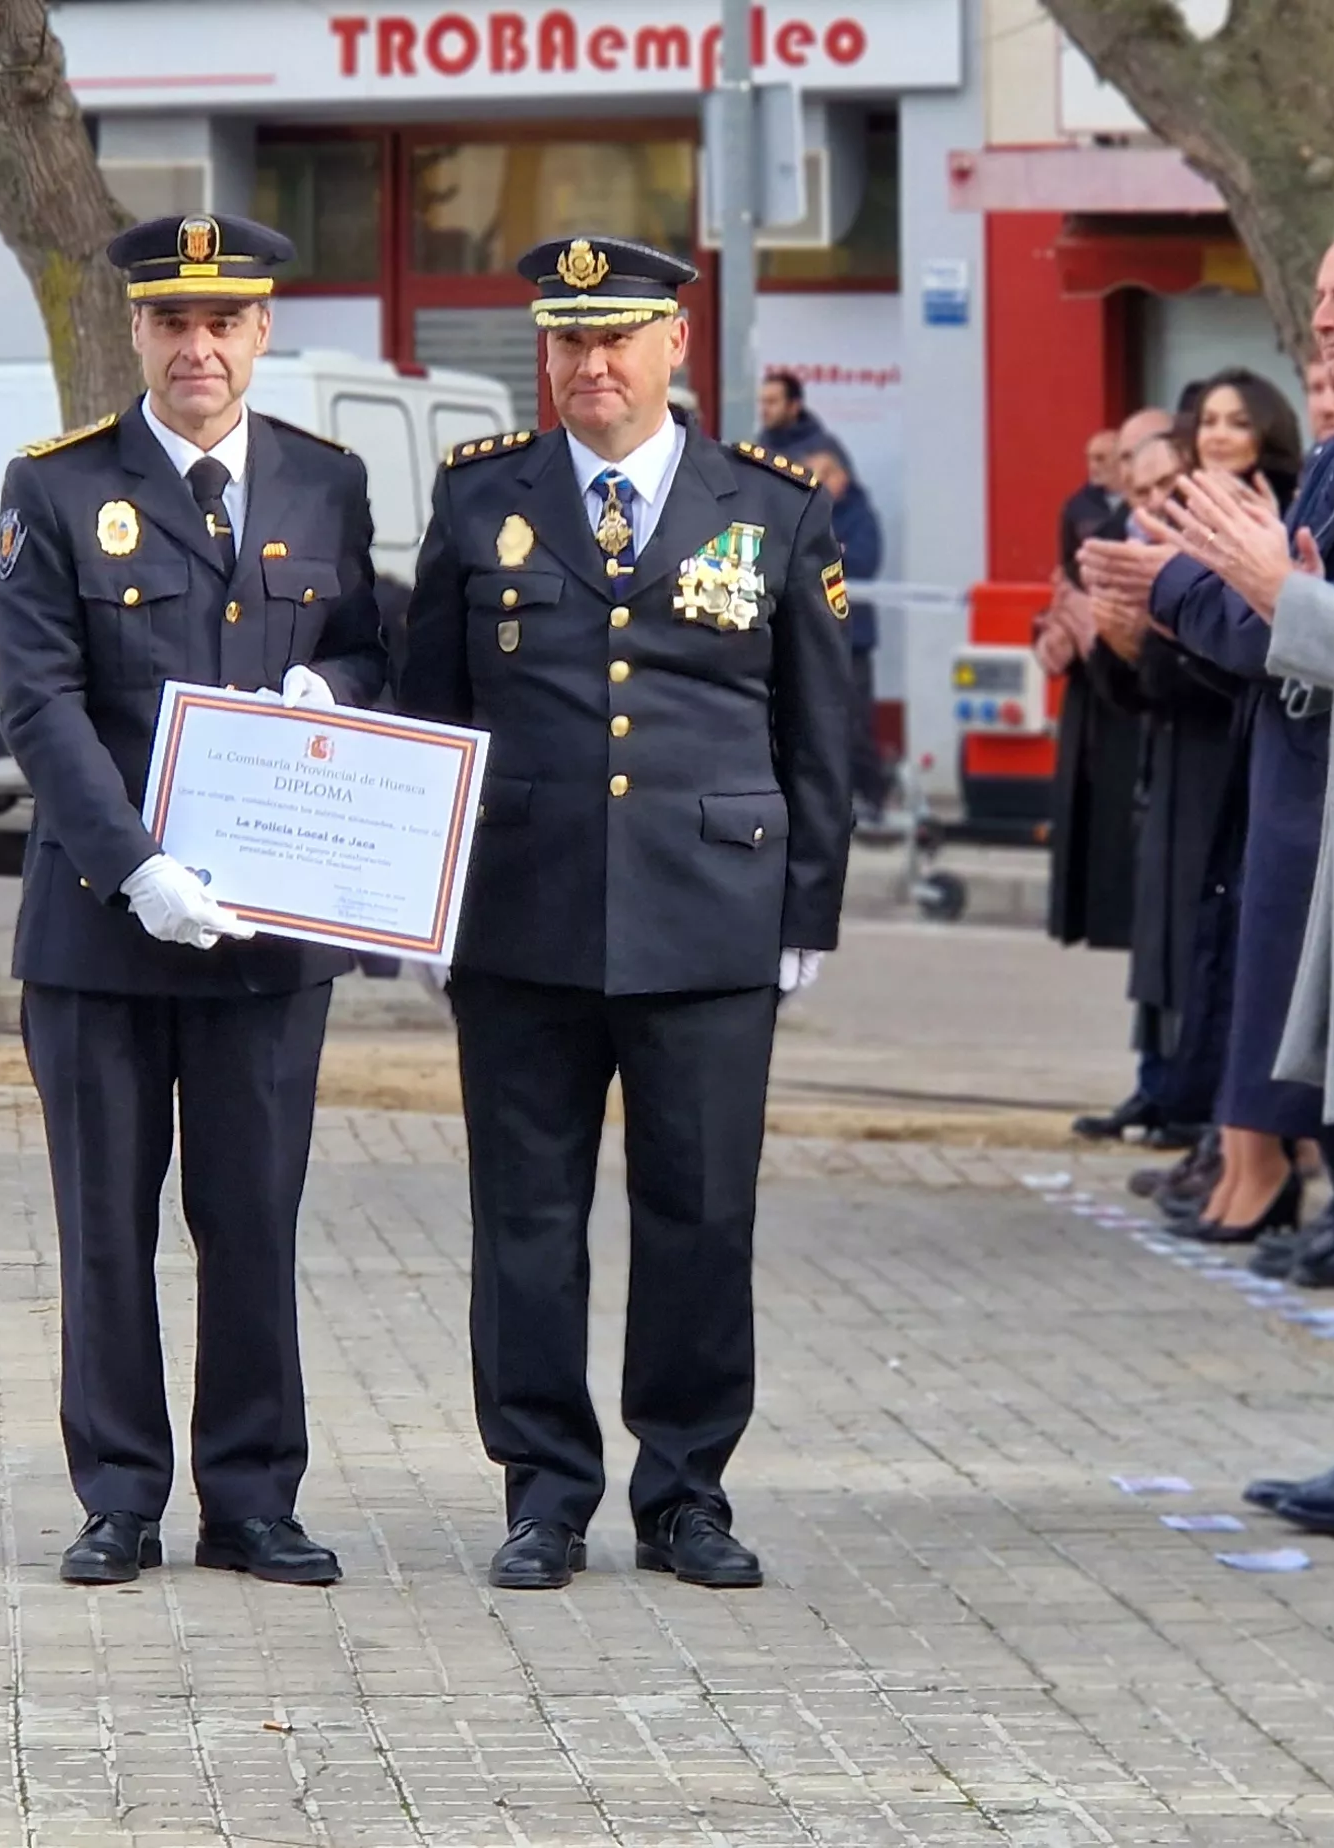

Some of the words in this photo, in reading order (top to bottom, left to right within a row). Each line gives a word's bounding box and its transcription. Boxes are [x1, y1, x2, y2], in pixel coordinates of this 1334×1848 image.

[208, 748, 222, 761] La
[296, 761, 357, 782] Provincial
[360, 773, 376, 786] de
[380, 777, 426, 795] Huesca
[274, 776, 354, 803] DIPLOMA
[236, 816, 250, 827] La
[297, 827, 328, 841] Local
[331, 834, 345, 844] de
[348, 837, 376, 850] Jaca
